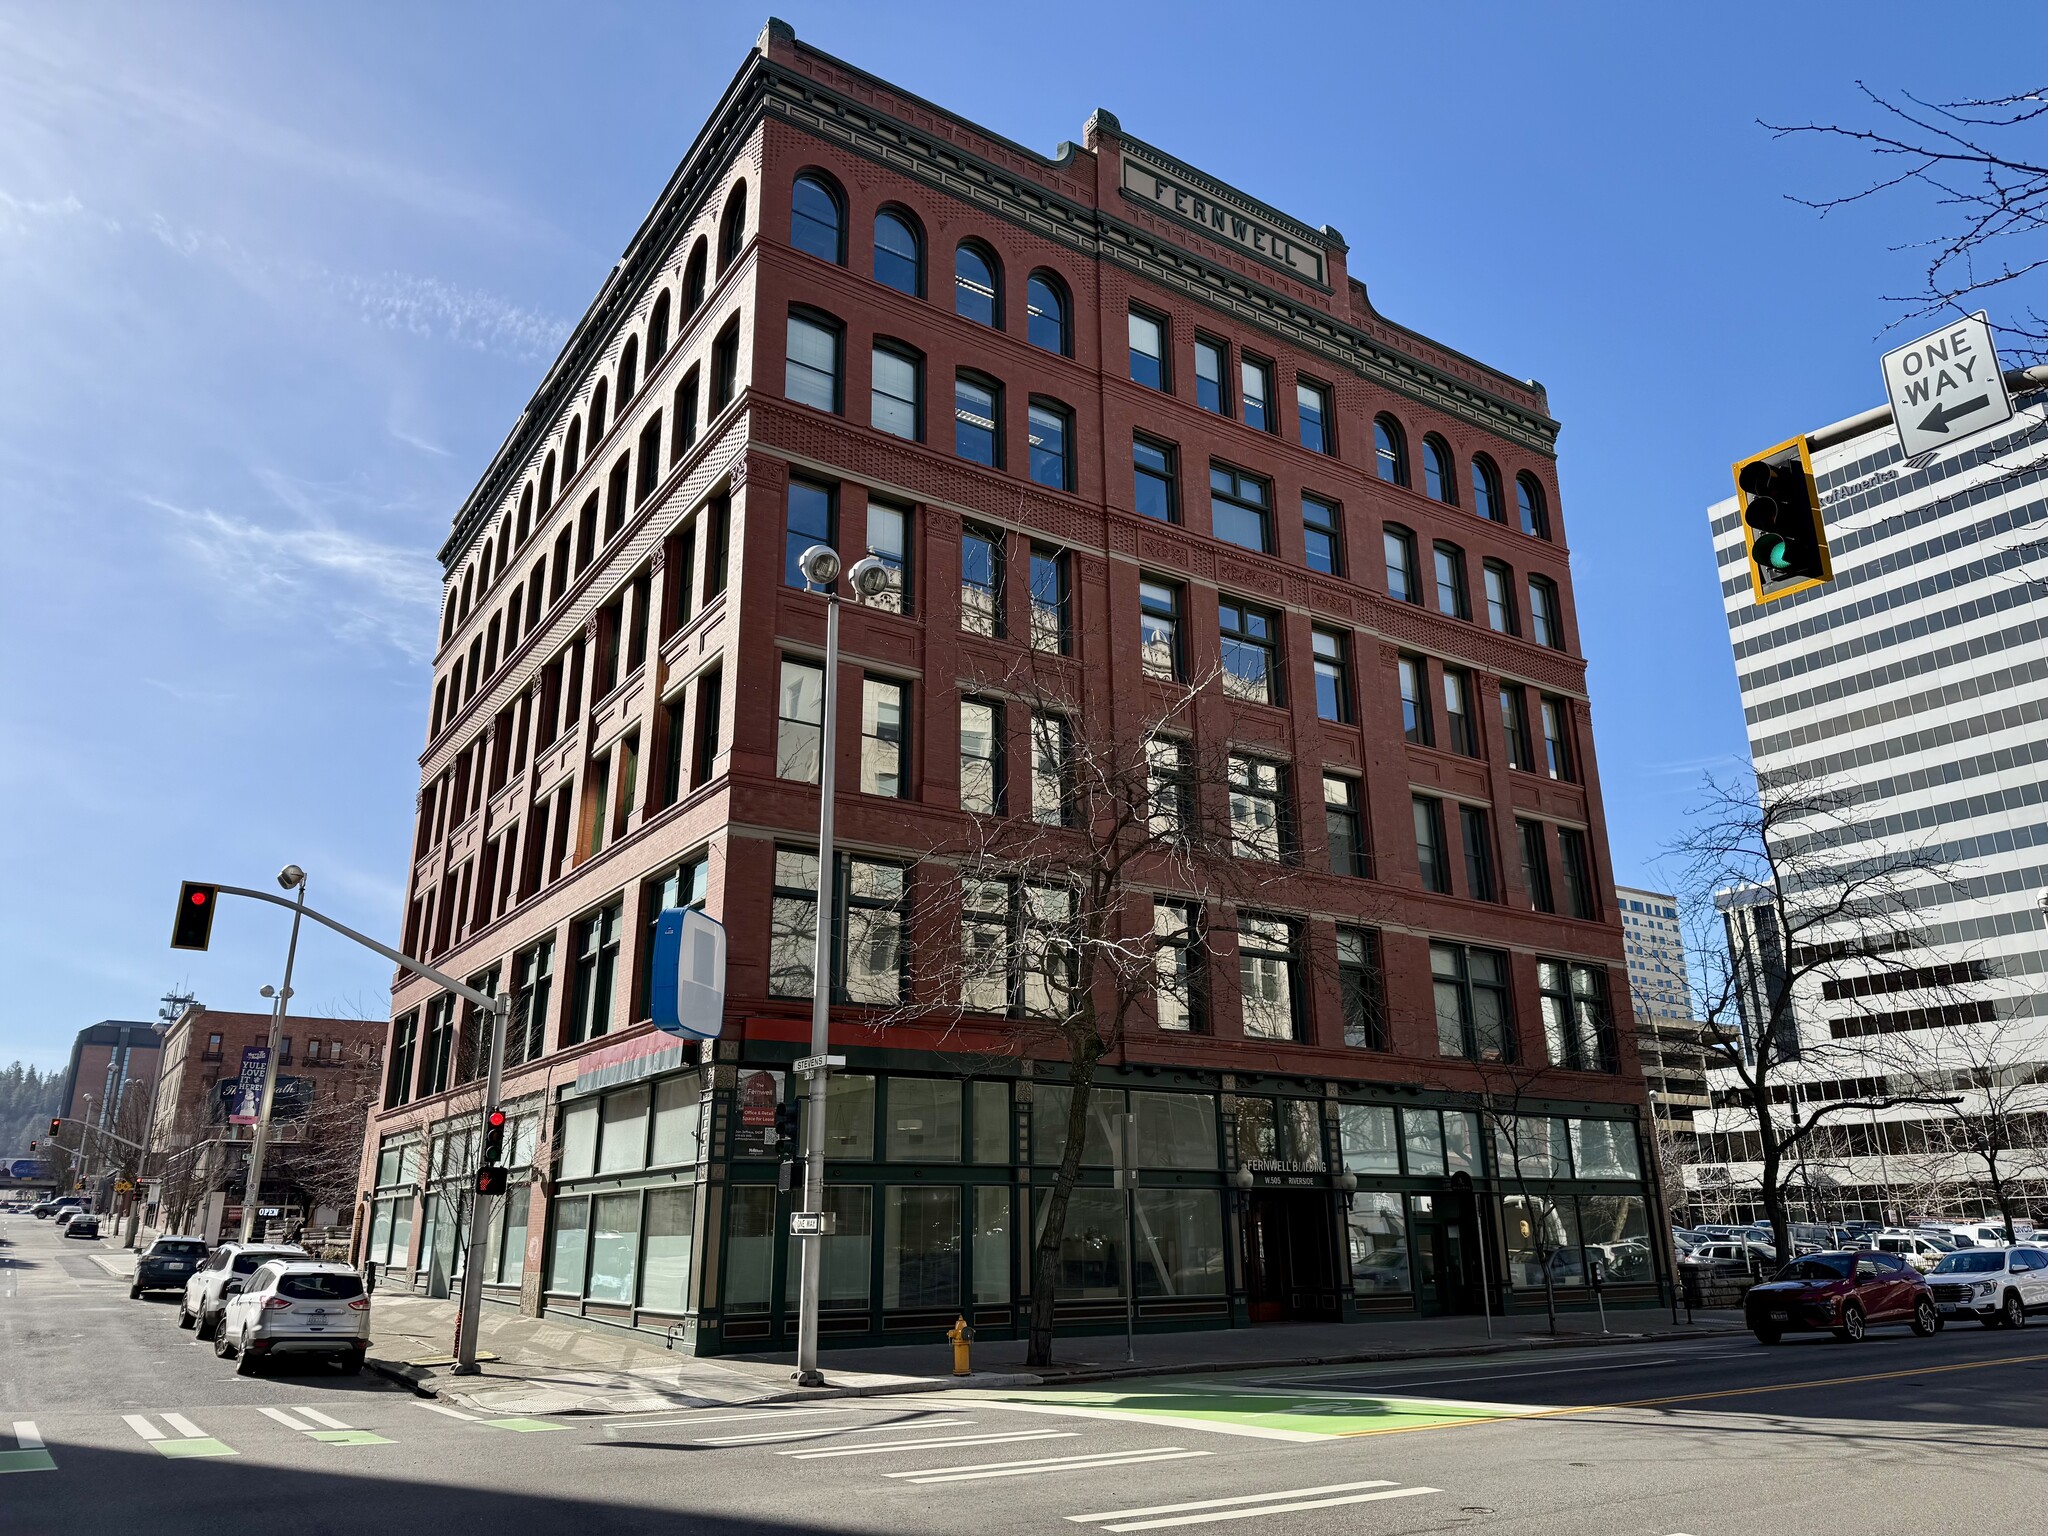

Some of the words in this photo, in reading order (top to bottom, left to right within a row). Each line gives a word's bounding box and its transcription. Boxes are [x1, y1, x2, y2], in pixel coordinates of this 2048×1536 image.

[1155, 178, 1297, 267] FERNWELL
[1902, 328, 1972, 376] ONE
[1904, 355, 1977, 407] WAY
[1839, 469, 1900, 499] America
[243, 1061, 266, 1070] YULE
[797, 1057, 823, 1070] STEVENS
[241, 1069, 265, 1077] LOVE
[222, 1085, 238, 1096] Th
[239, 1083, 262, 1091] HERE!
[1247, 1159, 1291, 1172] FERNWELL
[1288, 1177, 1314, 1185] RIVERSIDE
[258, 1208, 279, 1216] OPEN
[806, 1219, 816, 1228] WAY
